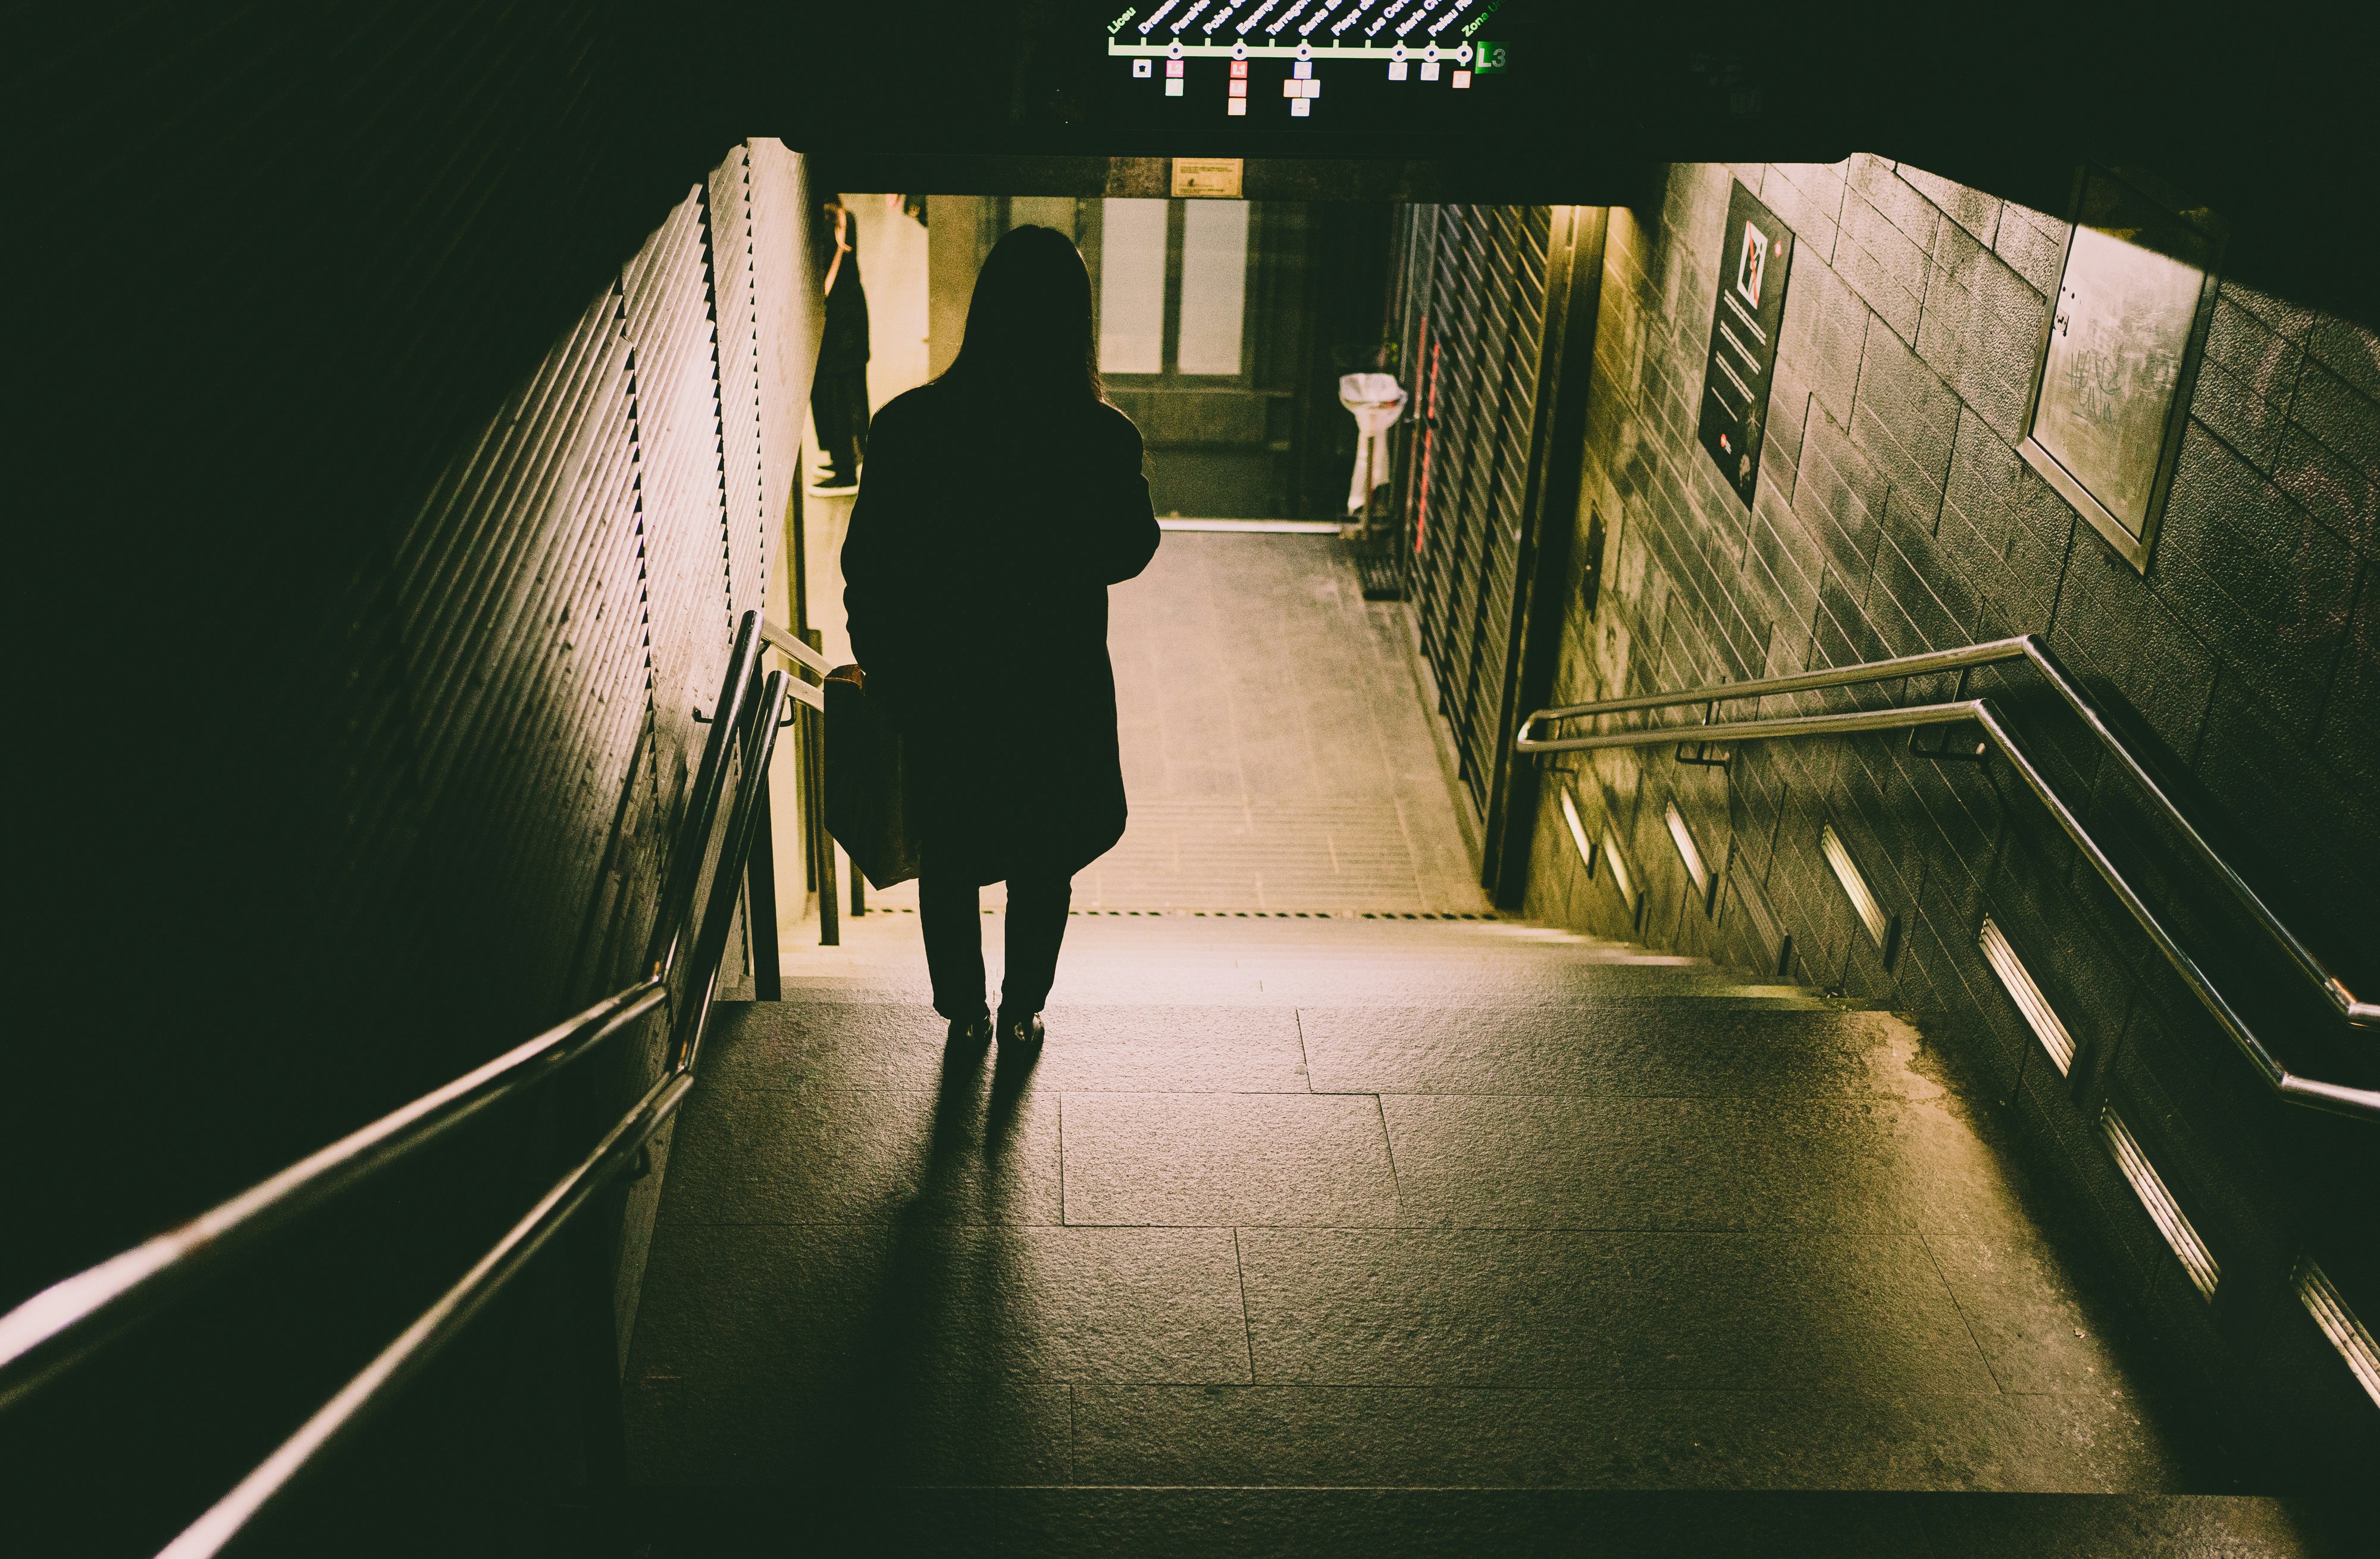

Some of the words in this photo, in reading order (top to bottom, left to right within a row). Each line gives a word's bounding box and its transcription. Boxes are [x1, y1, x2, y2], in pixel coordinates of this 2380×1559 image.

[1107, 7, 1136, 34] Liceu
[1202, 7, 1233, 35] Poble
[1298, 8, 1329, 36] Sants
[1330, 8, 1362, 36] Plaça
[1364, 17, 1386, 36] Les
[1395, 9, 1427, 37] Maria
[1427, 9, 1458, 37] Palau
[1461, 12, 1489, 37] Zona
[1168, 64, 1183, 74] L2
[1232, 64, 1245, 75] L1
[1477, 48, 1505, 67] L3
